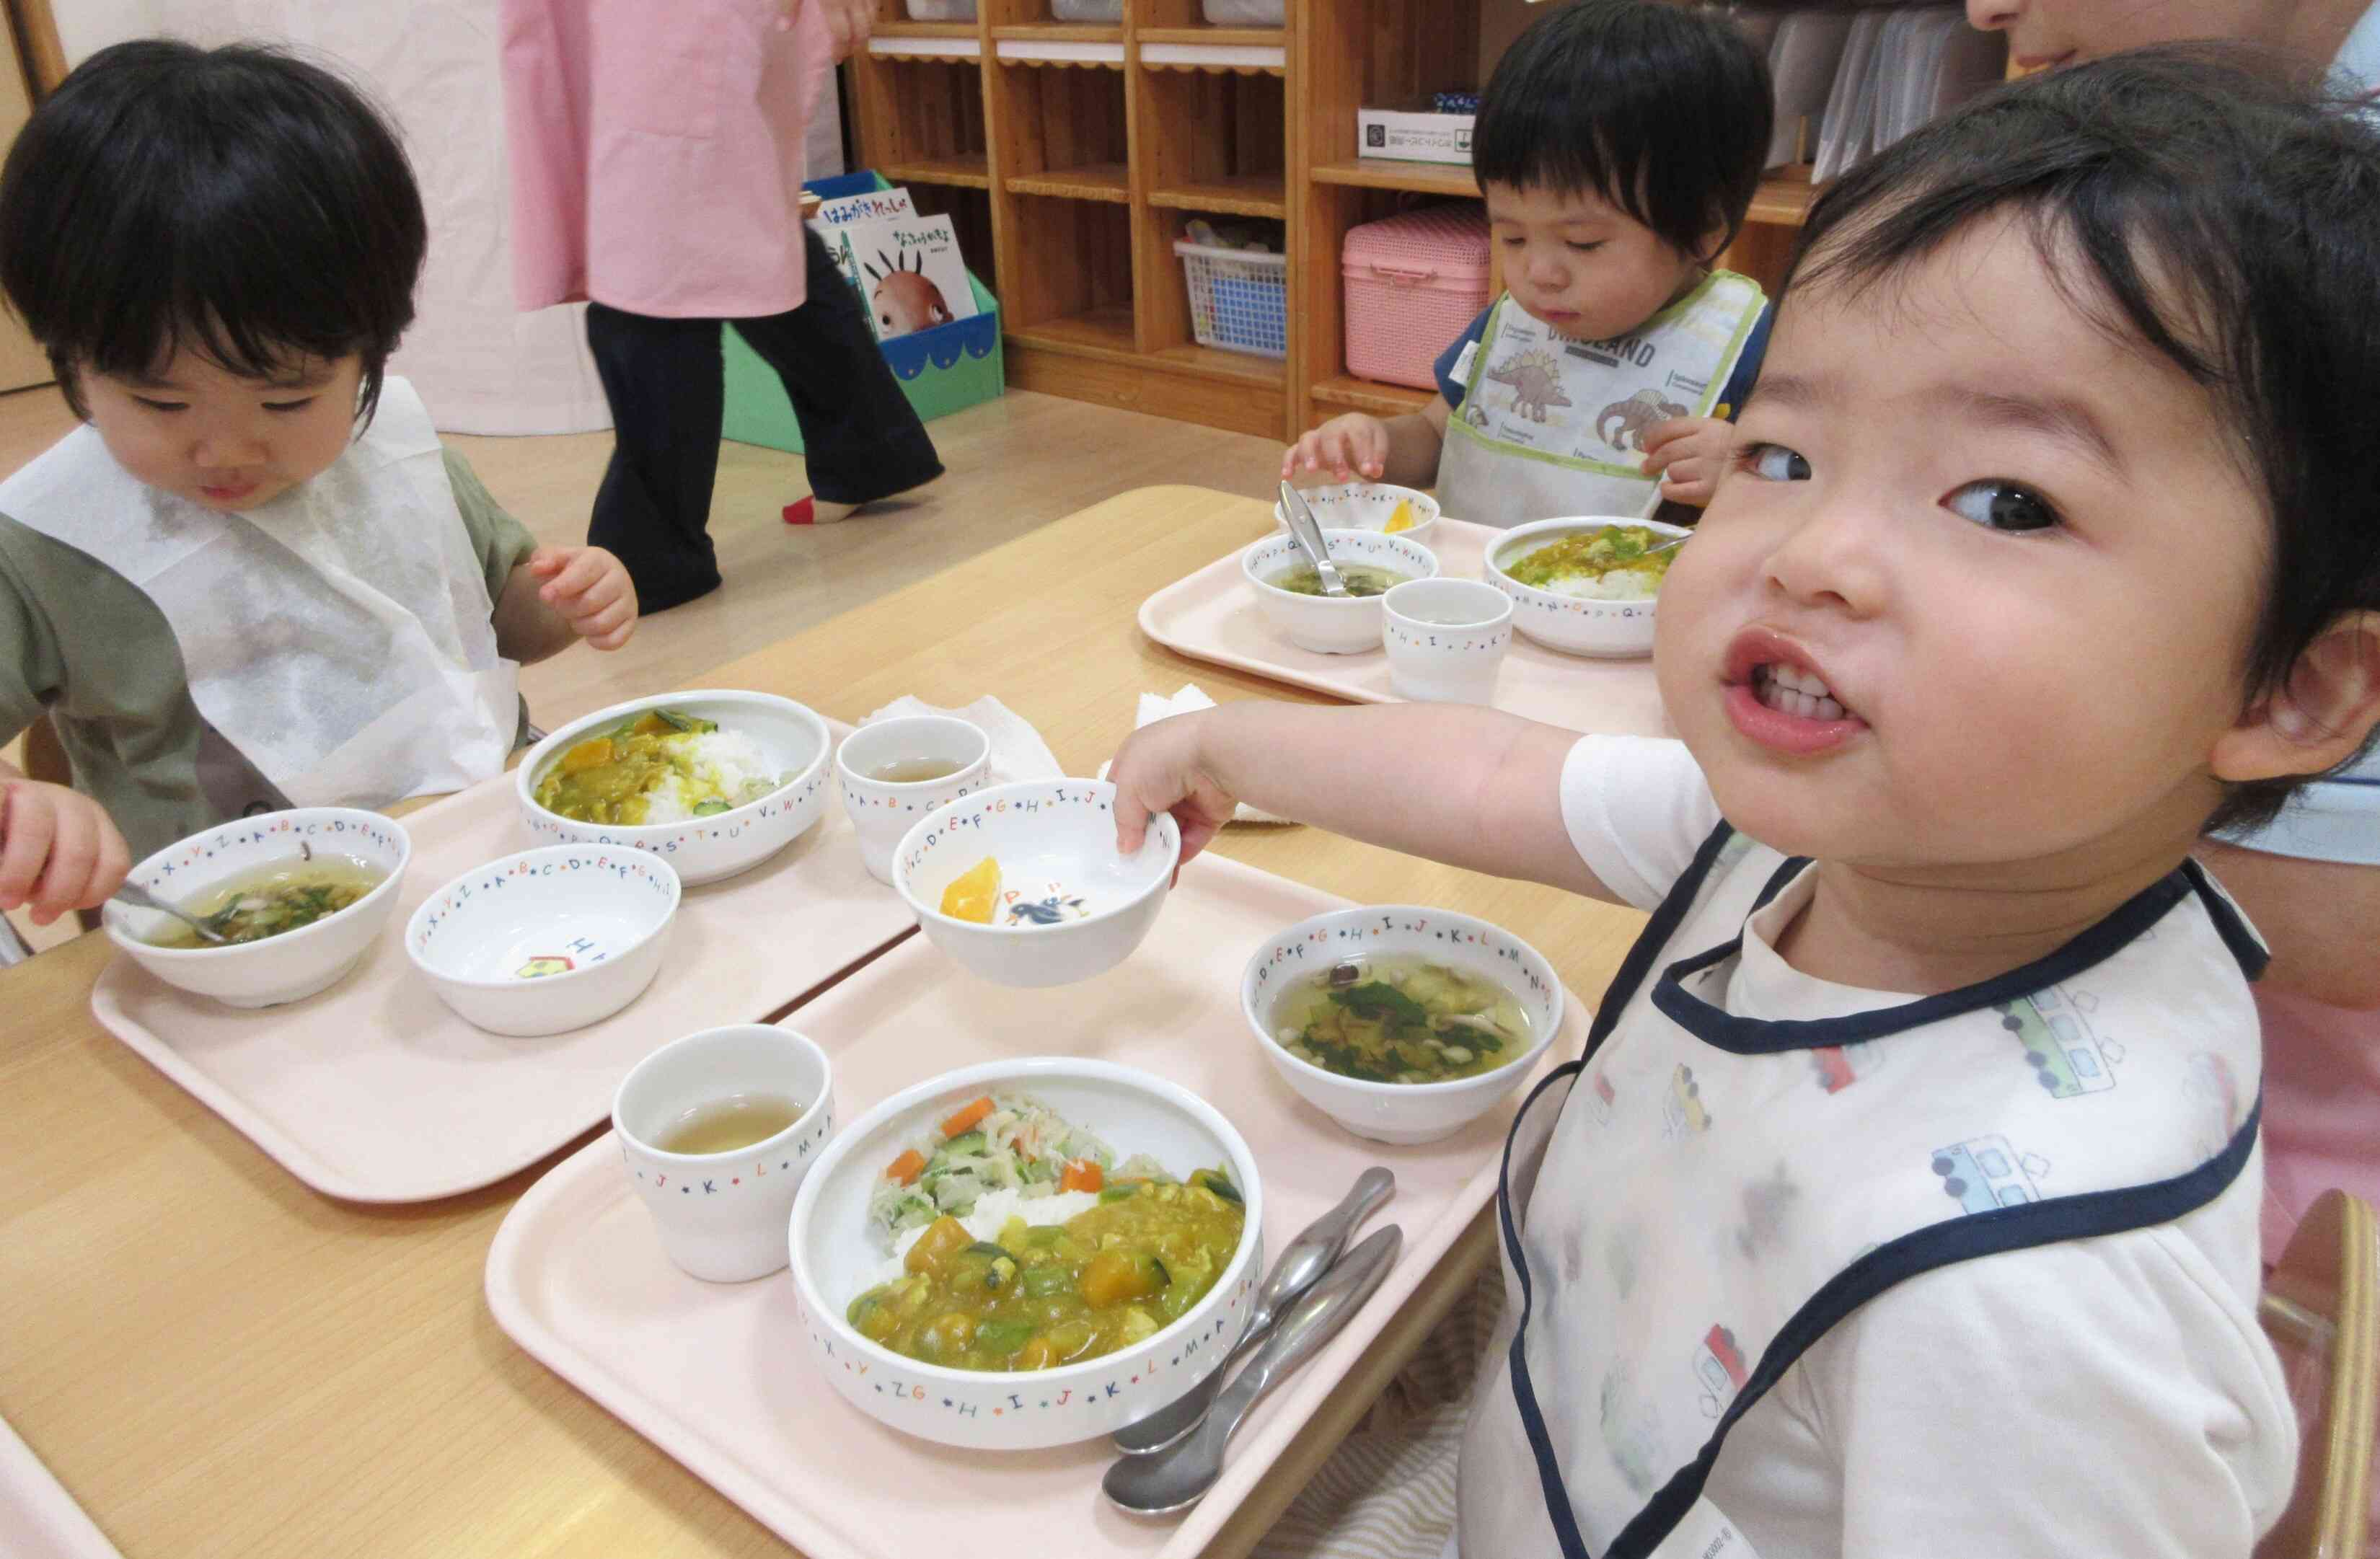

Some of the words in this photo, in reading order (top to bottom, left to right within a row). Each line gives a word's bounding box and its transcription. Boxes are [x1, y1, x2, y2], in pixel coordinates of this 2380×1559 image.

[1546, 324, 1656, 368] DAND
[1288, 541, 1297, 549] Q
[1328, 542, 1334, 550] S
[1389, 540, 1394, 549] V
[1548, 601, 1558, 611] N
[1623, 608, 1633, 617] Q
[1429, 636, 1436, 645] I
[666, 841, 676, 852] S
[730, 827, 739, 839] U
[759, 806, 767, 817] V
[784, 800, 794, 811] W
[889, 798, 896, 808] B
[925, 800, 934, 811] C
[927, 834, 936, 845] D
[950, 816, 958, 830] E
[974, 814, 982, 828] F
[997, 800, 1005, 812] G
[1026, 800, 1039, 813] H
[1056, 789, 1066, 801] I
[1085, 791, 1096, 803] J
[162, 862, 175, 875] X
[216, 835, 229, 848] Z
[281, 820, 288, 831] B
[307, 823, 316, 835] C
[335, 821, 345, 831] D
[460, 885, 471, 898] Z
[495, 877, 505, 887] A
[520, 862, 528, 873] B
[543, 865, 552, 875] C
[568, 860, 580, 869] D
[598, 857, 608, 868] E
[620, 867, 627, 879] F
[1259, 968, 1266, 979] D
[1277, 947, 1282, 961] E
[1297, 944, 1303, 958] F
[1319, 929, 1327, 942] G
[1351, 929, 1362, 940] H
[1383, 917, 1393, 929] I
[1415, 919, 1427, 932] J
[1451, 929, 1461, 942] K
[1481, 932, 1489, 945] L
[1508, 949, 1518, 963] M
[1530, 976, 1538, 989] N
[656, 1175, 666, 1186] J
[703, 1180, 717, 1194] K
[757, 1163, 766, 1177] L
[798, 1139, 810, 1157] M
[892, 1382, 907, 1397] Z
[912, 1385, 925, 1400] G
[959, 1402, 977, 1417] H
[1008, 1394, 1023, 1409] I
[1057, 1390, 1071, 1405] J
[1106, 1382, 1119, 1397] K
[1186, 1339, 1198, 1358] M
